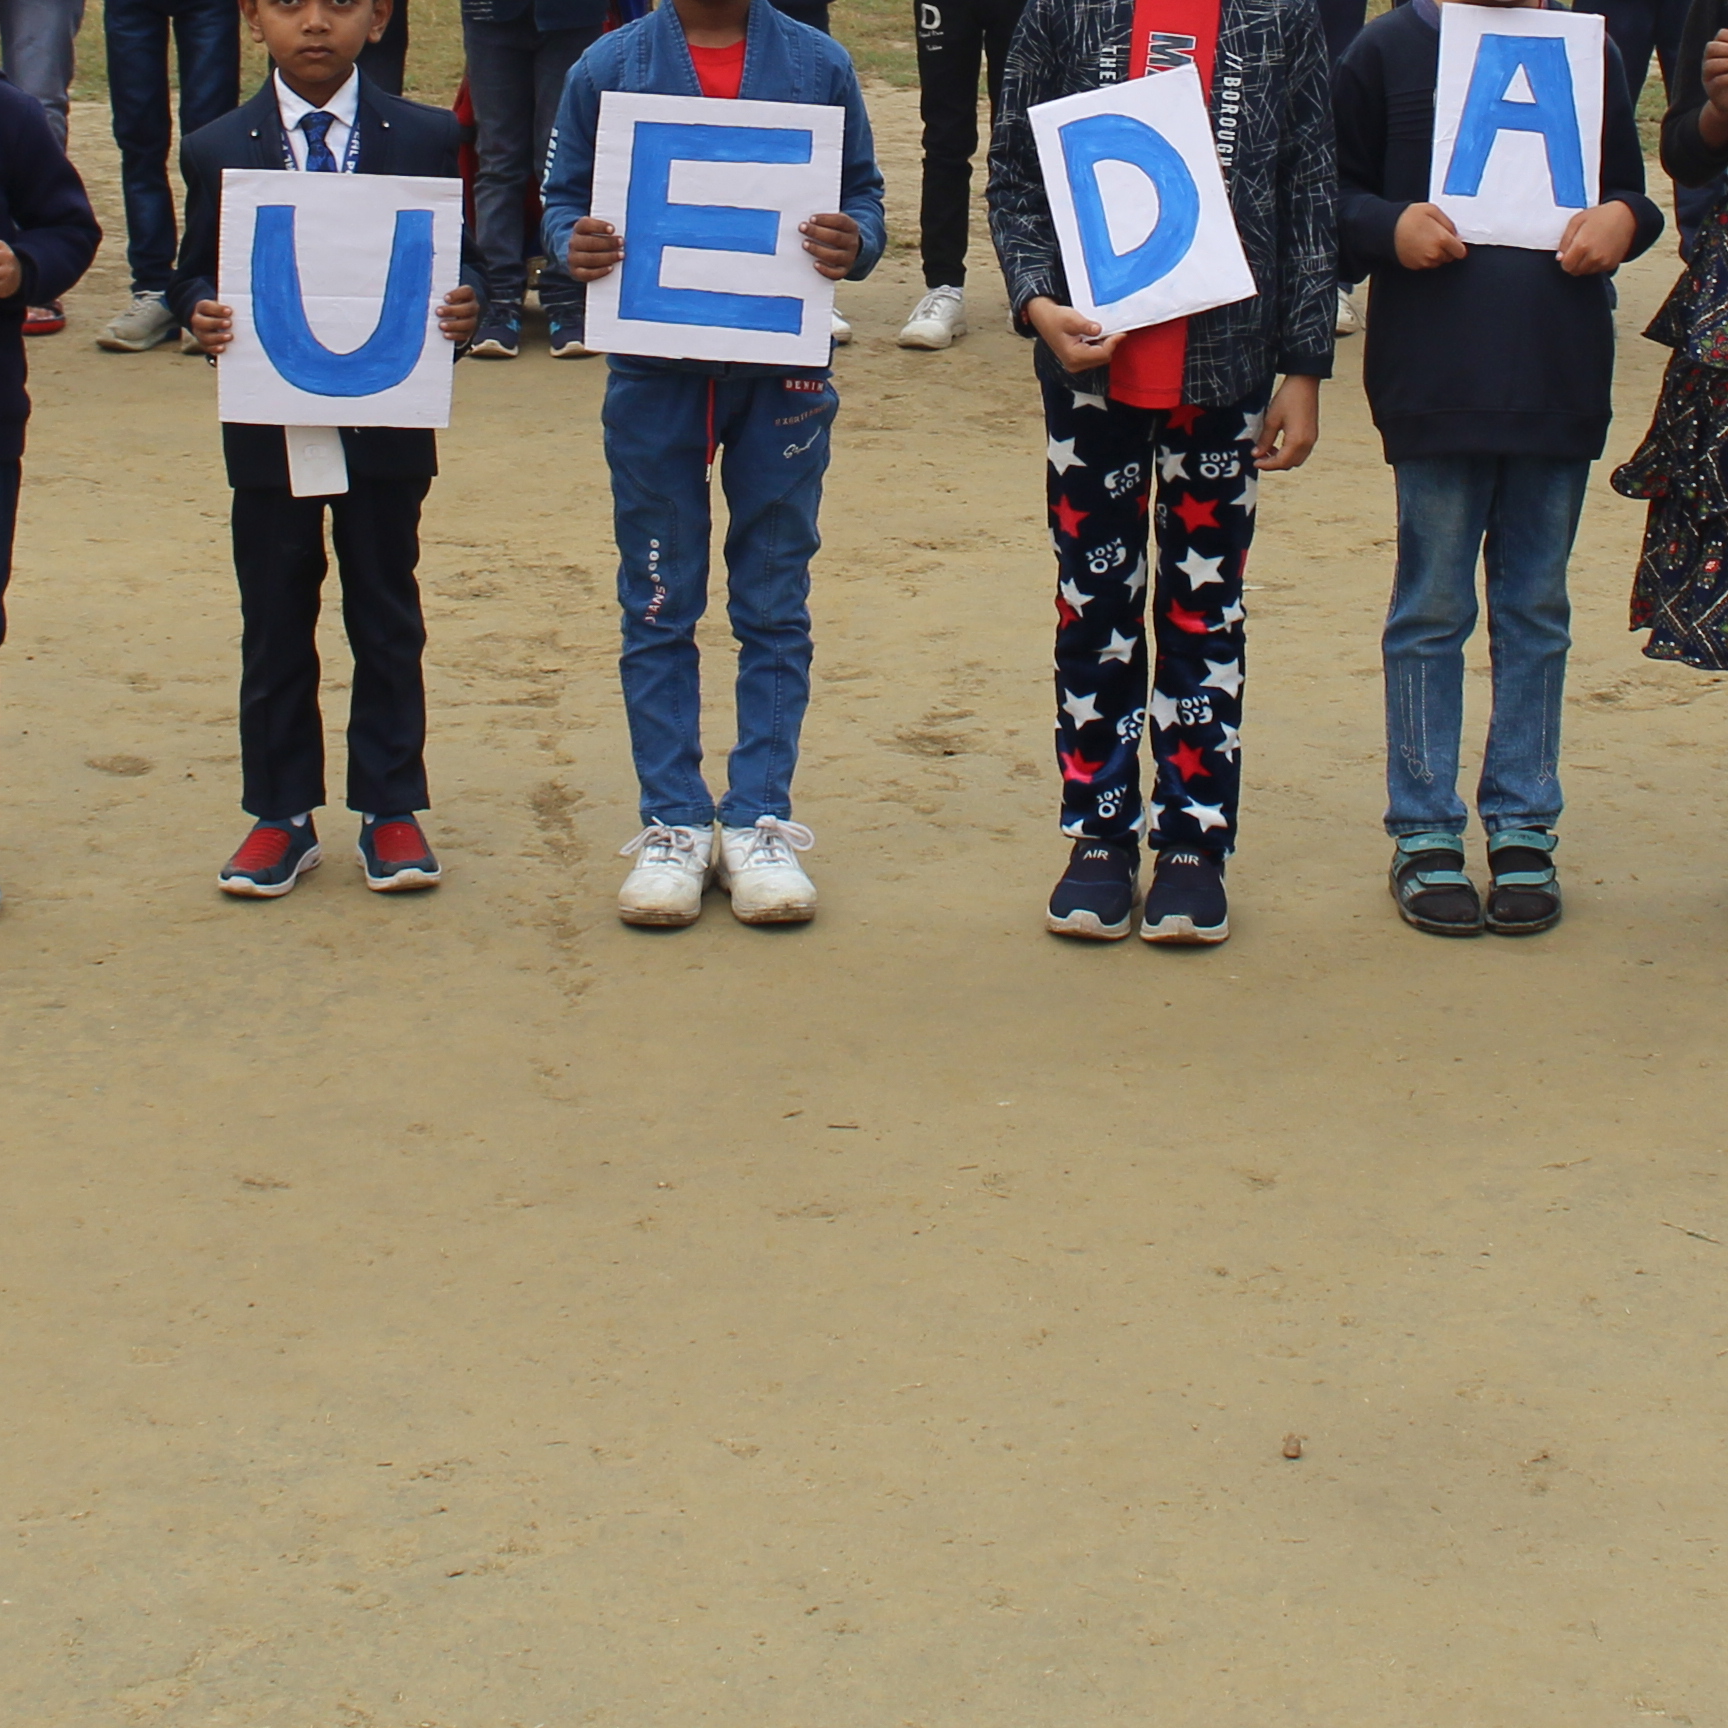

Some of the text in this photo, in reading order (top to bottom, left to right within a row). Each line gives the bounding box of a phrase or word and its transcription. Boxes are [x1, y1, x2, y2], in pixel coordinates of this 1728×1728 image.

[1444, 34, 1586, 209] A
[618, 121, 813, 335] E
[1059, 113, 1201, 306] D
[251, 204, 434, 398] U
[785, 379, 824, 391] DENIM
[1083, 849, 1109, 861] AIR
[1171, 854, 1200, 866] AIR
